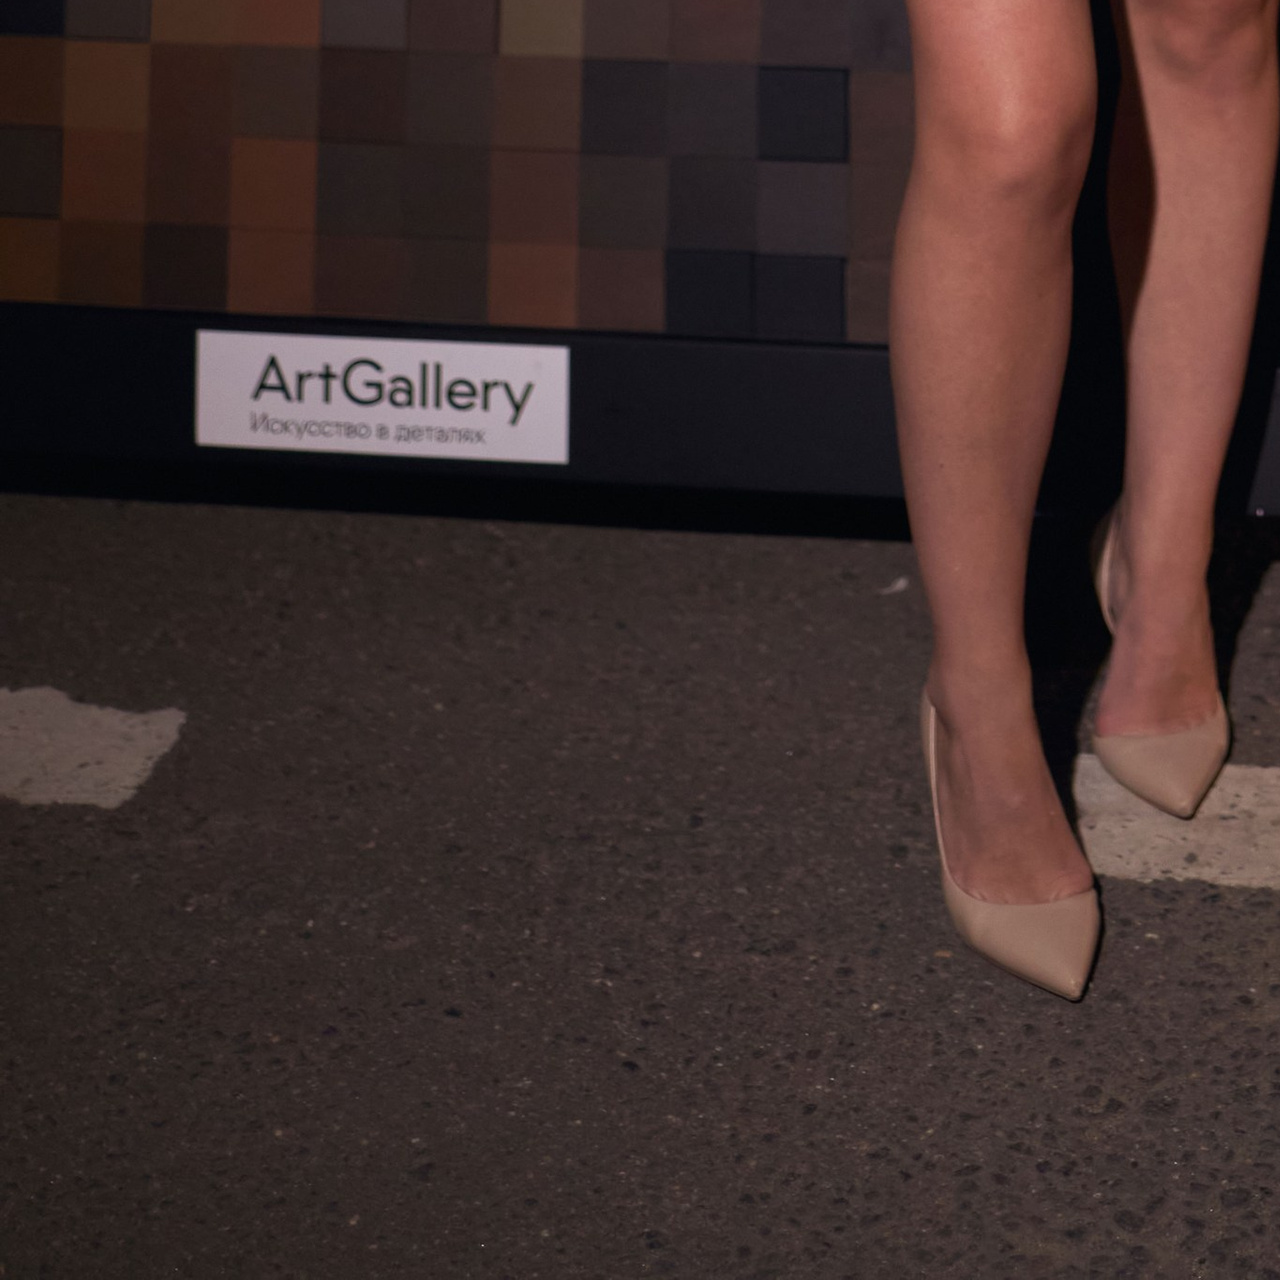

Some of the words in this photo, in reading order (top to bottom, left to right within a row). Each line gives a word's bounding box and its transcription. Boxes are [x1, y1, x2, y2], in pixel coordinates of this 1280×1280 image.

[251, 354, 534, 426] ArtGallery
[249, 412, 371, 440] Искусство
[376, 423, 390, 440] в
[395, 423, 487, 444] деталях
